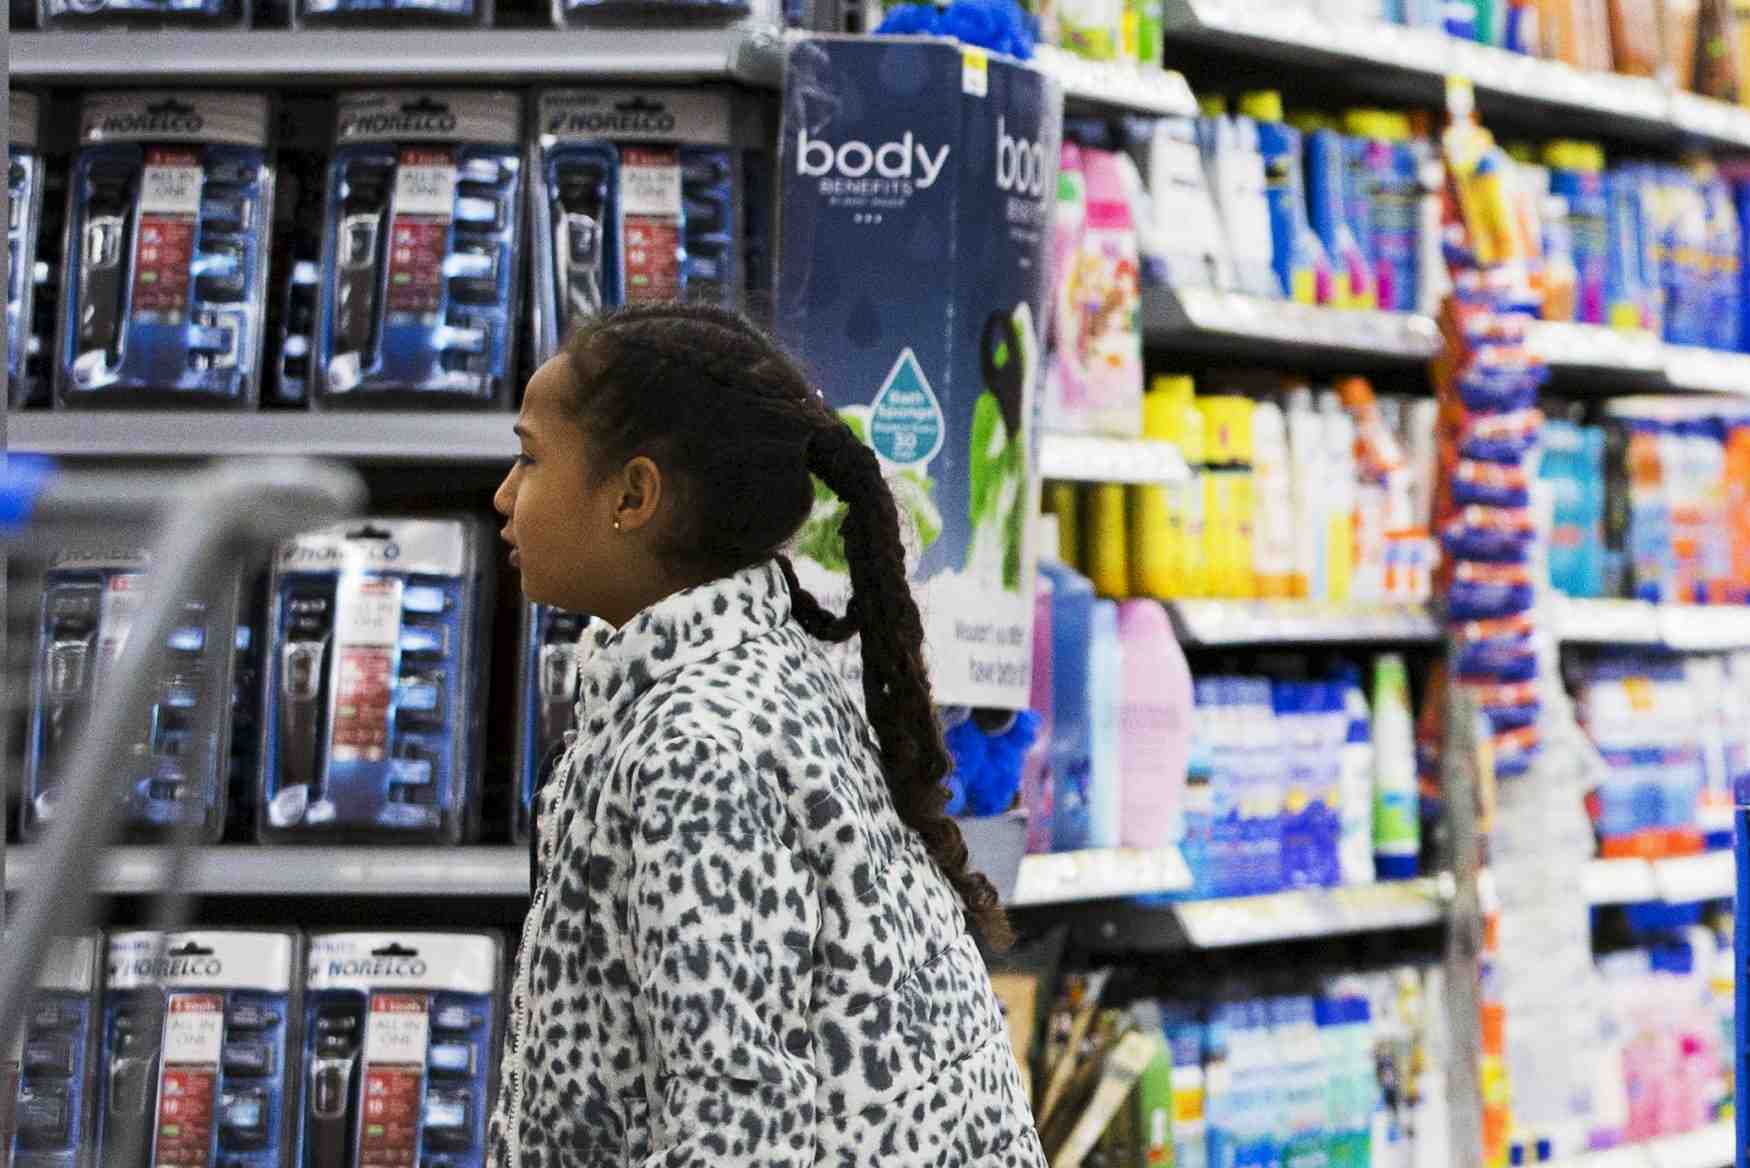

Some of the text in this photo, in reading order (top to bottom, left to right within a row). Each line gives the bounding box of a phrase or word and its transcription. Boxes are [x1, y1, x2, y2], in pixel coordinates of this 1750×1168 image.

[567, 111, 676, 132] NORELCO
[796, 127, 950, 189] body
[818, 177, 915, 197] BENEFITS
[328, 959, 428, 977] NORELCO
